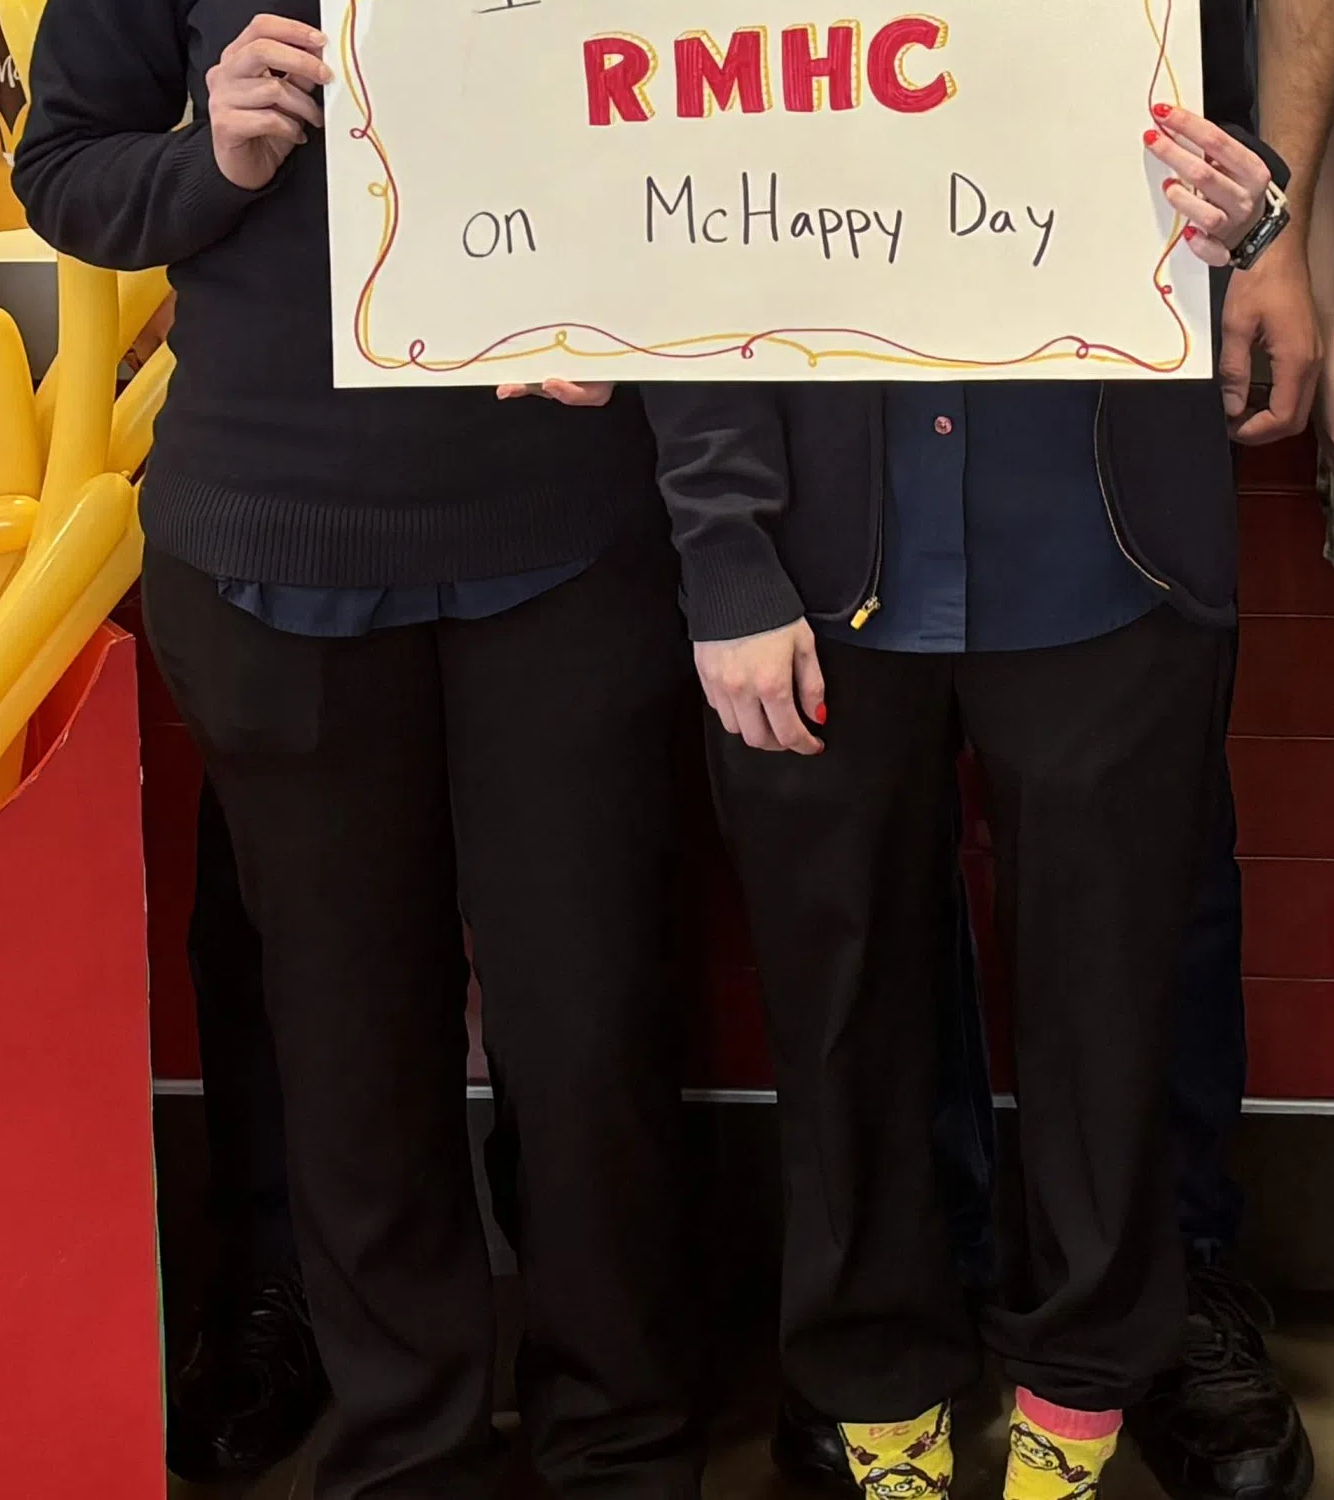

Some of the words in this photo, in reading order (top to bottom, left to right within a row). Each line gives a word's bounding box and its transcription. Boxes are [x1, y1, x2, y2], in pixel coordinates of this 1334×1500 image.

[583, 14, 958, 127] RMHC
[463, 208, 536, 259] on
[644, 171, 905, 264] McHappy
[950, 172, 1056, 268] Day
